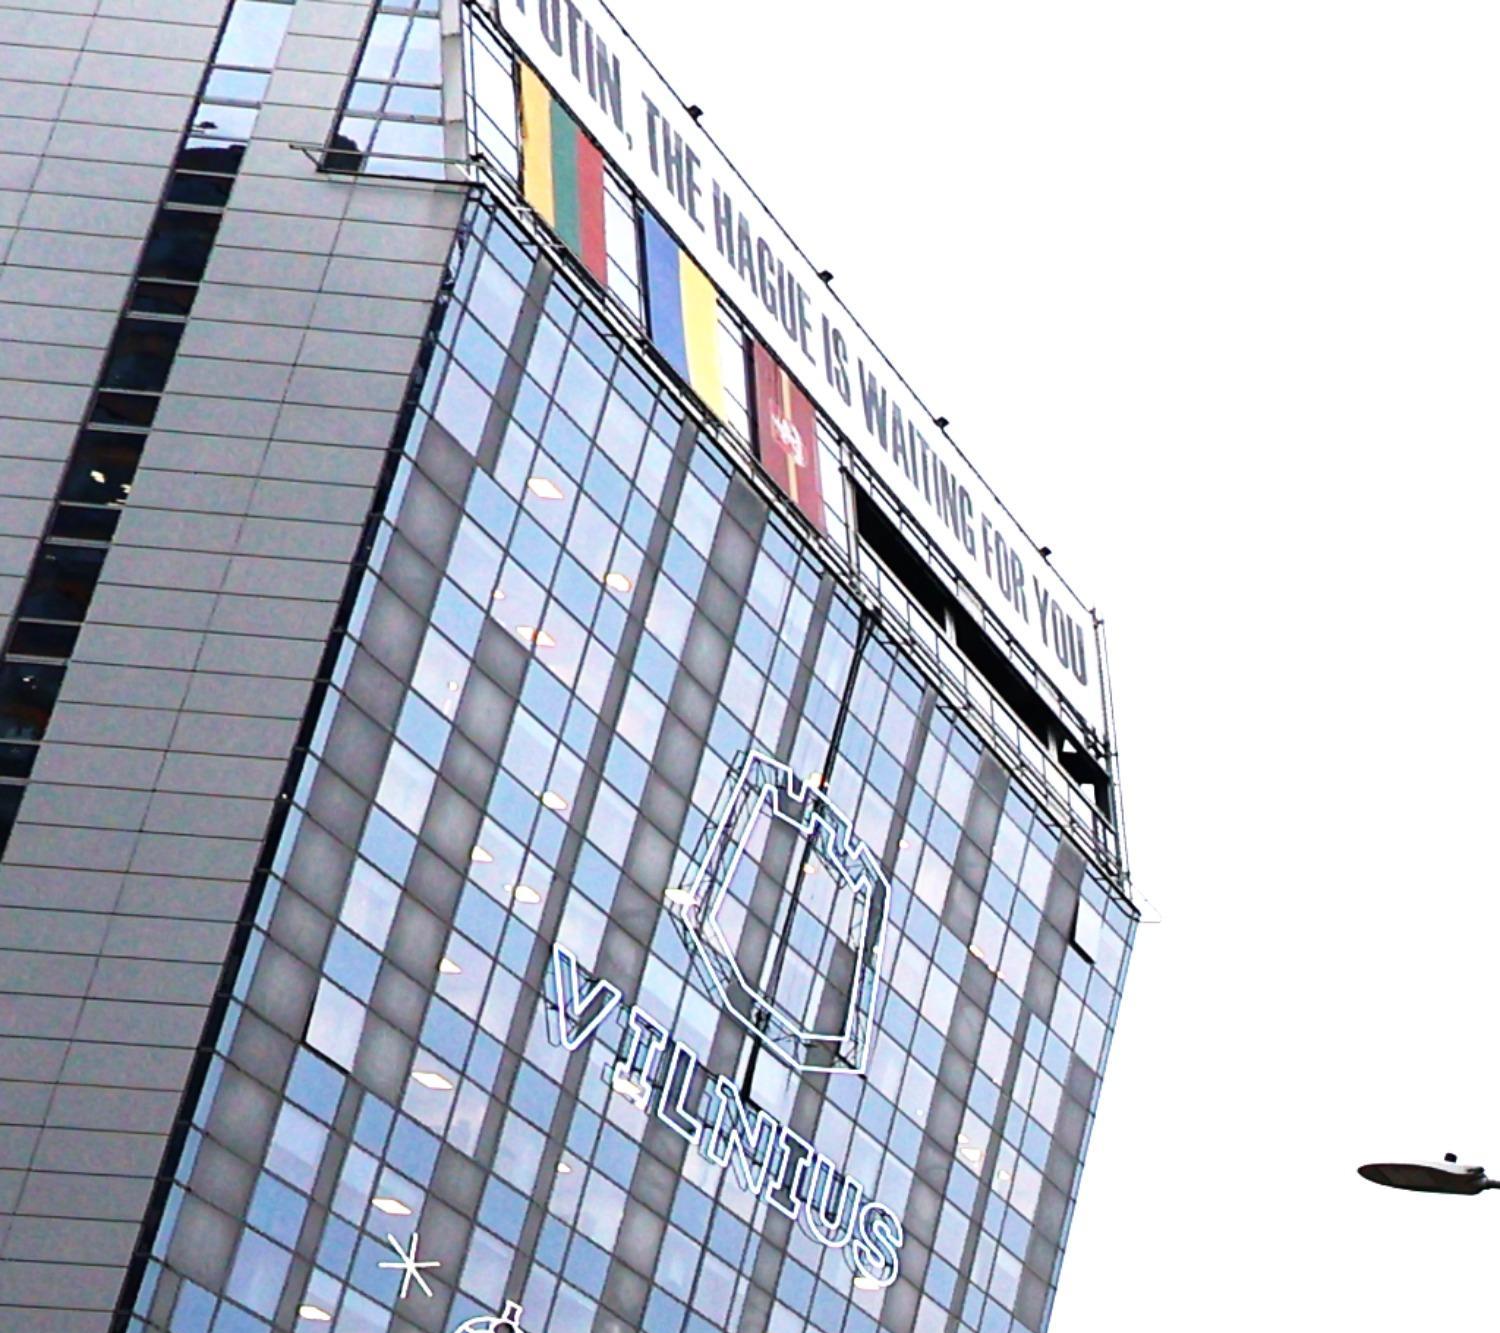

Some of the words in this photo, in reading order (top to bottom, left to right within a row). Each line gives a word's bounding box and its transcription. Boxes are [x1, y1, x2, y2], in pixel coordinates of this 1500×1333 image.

[516, 0, 634, 151] UTIN,
[641, 90, 706, 234] THE
[712, 177, 817, 367] HAGUE
[821, 312, 852, 407] IS
[857, 356, 977, 562] WAITING
[980, 511, 1029, 625] FOR
[1032, 574, 1088, 687] YOU
[552, 941, 904, 1287] VILNIUS
